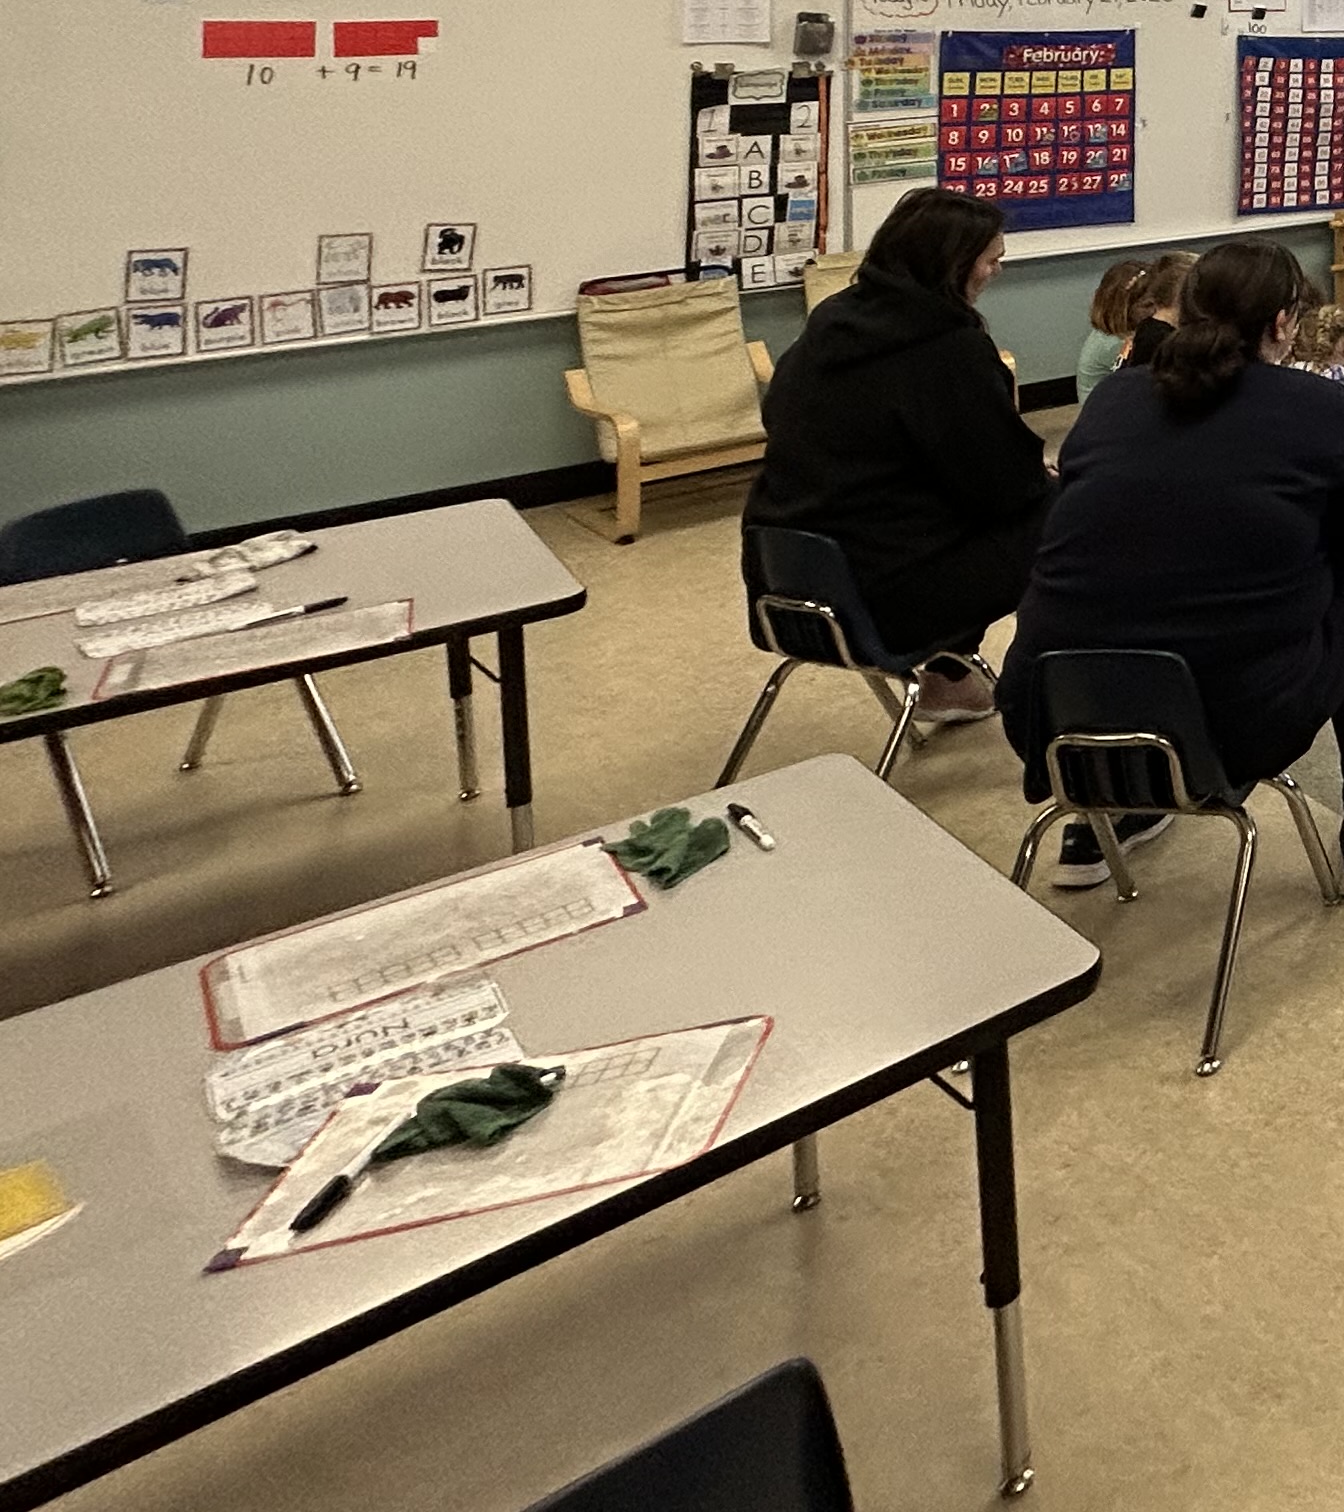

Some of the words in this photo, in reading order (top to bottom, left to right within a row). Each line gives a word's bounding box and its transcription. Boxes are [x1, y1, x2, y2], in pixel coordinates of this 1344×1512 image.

[1248, 22, 1267, 34] 100
[1022, 47, 1100, 65] February
[246, 64, 275, 86] 10
[318, 65, 335, 80] +
[344, 62, 362, 82] 9
[395, 60, 417, 80] 19
[800, 105, 814, 129] 2
[951, 103, 958, 117] 1
[1008, 102, 1019, 116] 3
[1039, 102, 1049, 115] 4
[1065, 101, 1075, 114] 5
[1092, 99, 1101, 112] 6
[1115, 98, 1124, 111] 7
[701, 108, 717, 133] 1
[948, 131, 959, 145] 8
[978, 130, 989, 144] 9
[1006, 128, 1024, 142] 10
[1110, 123, 1126, 137] 14
[743, 141, 765, 159] A
[949, 157, 966, 171] 15
[1033, 152, 1049, 165] 18
[1061, 150, 1078, 164] 19
[1112, 148, 1127, 162] 21
[748, 170, 763, 189] B
[975, 183, 997, 197] 23
[1002, 180, 1024, 194] 24
[1028, 179, 1048, 193] 25
[1082, 176, 1102, 190] 27
[747, 204, 771, 225] C
[743, 234, 763, 253] D
[751, 263, 766, 284] E
